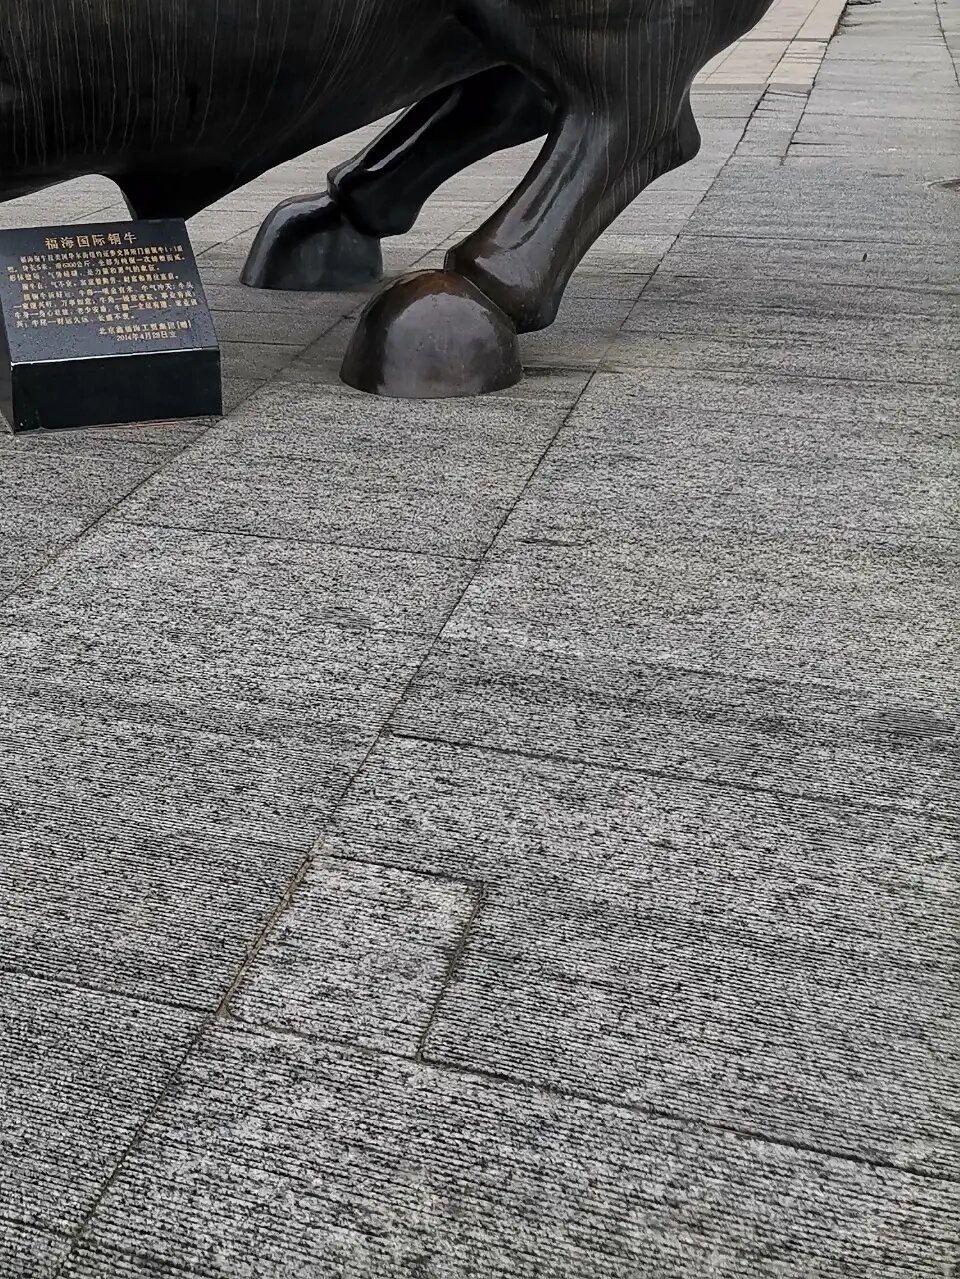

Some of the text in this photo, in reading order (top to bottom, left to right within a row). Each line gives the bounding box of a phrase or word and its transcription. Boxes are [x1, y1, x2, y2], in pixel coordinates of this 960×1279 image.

[44, 231, 138, 251] 福海国际铜牛
